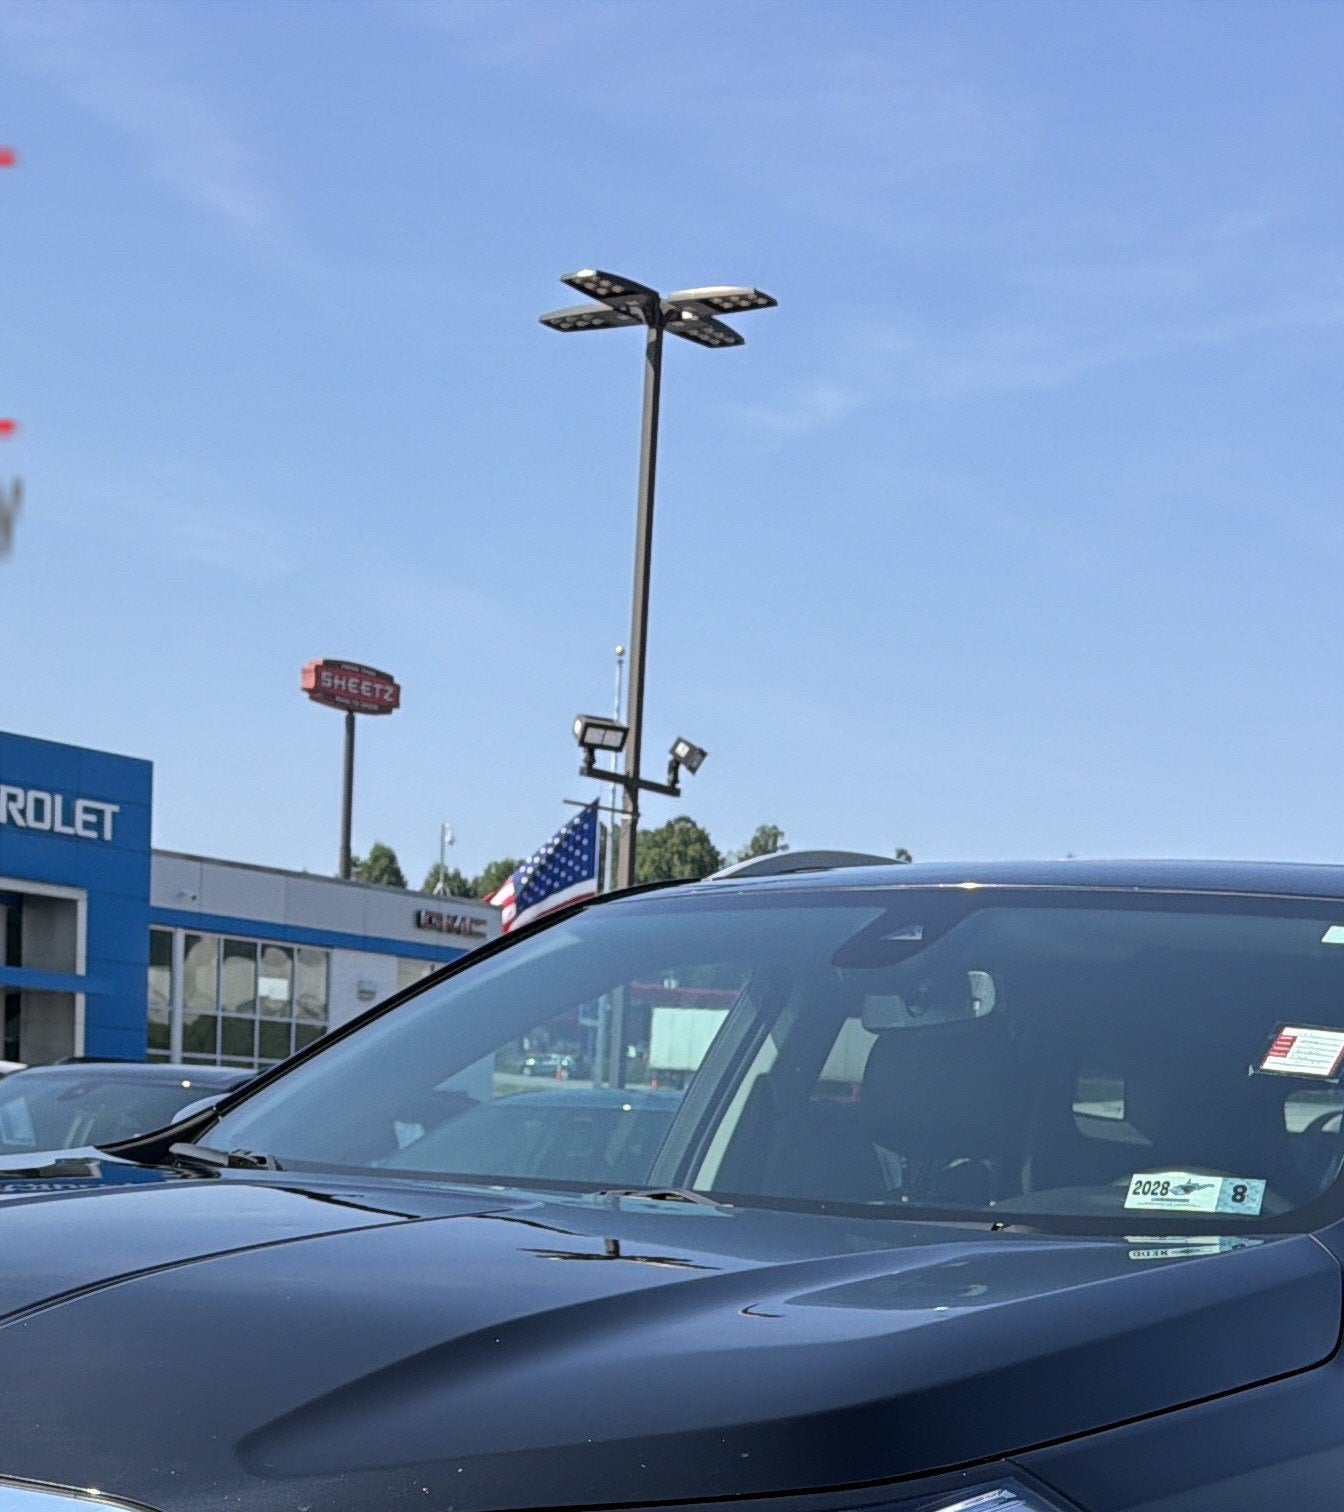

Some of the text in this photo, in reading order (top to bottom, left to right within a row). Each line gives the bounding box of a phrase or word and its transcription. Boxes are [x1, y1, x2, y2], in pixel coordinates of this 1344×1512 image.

[320, 670, 394, 702] SHEETZ
[1132, 1180, 1248, 1203] 2028 8
